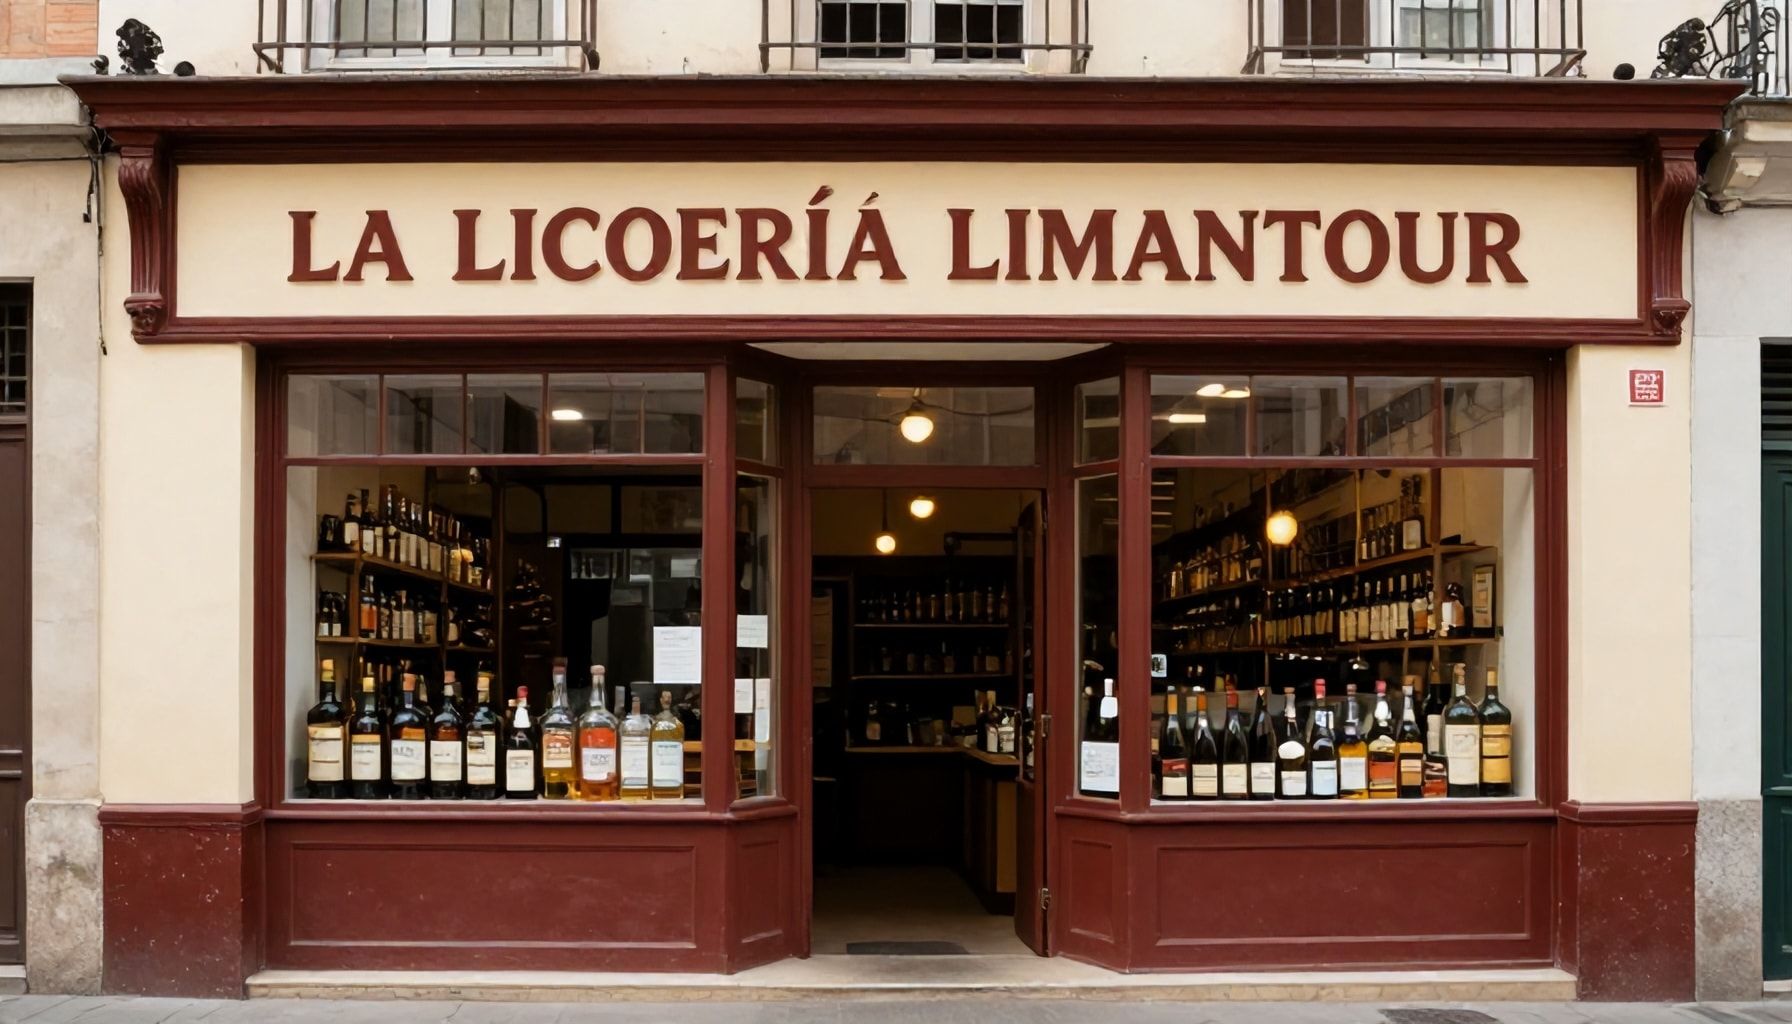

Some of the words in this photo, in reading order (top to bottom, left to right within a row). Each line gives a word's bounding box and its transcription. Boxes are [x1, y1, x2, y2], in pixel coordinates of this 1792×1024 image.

[288, 210, 415, 283] LA
[451, 185, 907, 283] LICOERÍÁ
[946, 208, 1529, 285] LIMANTOUR
